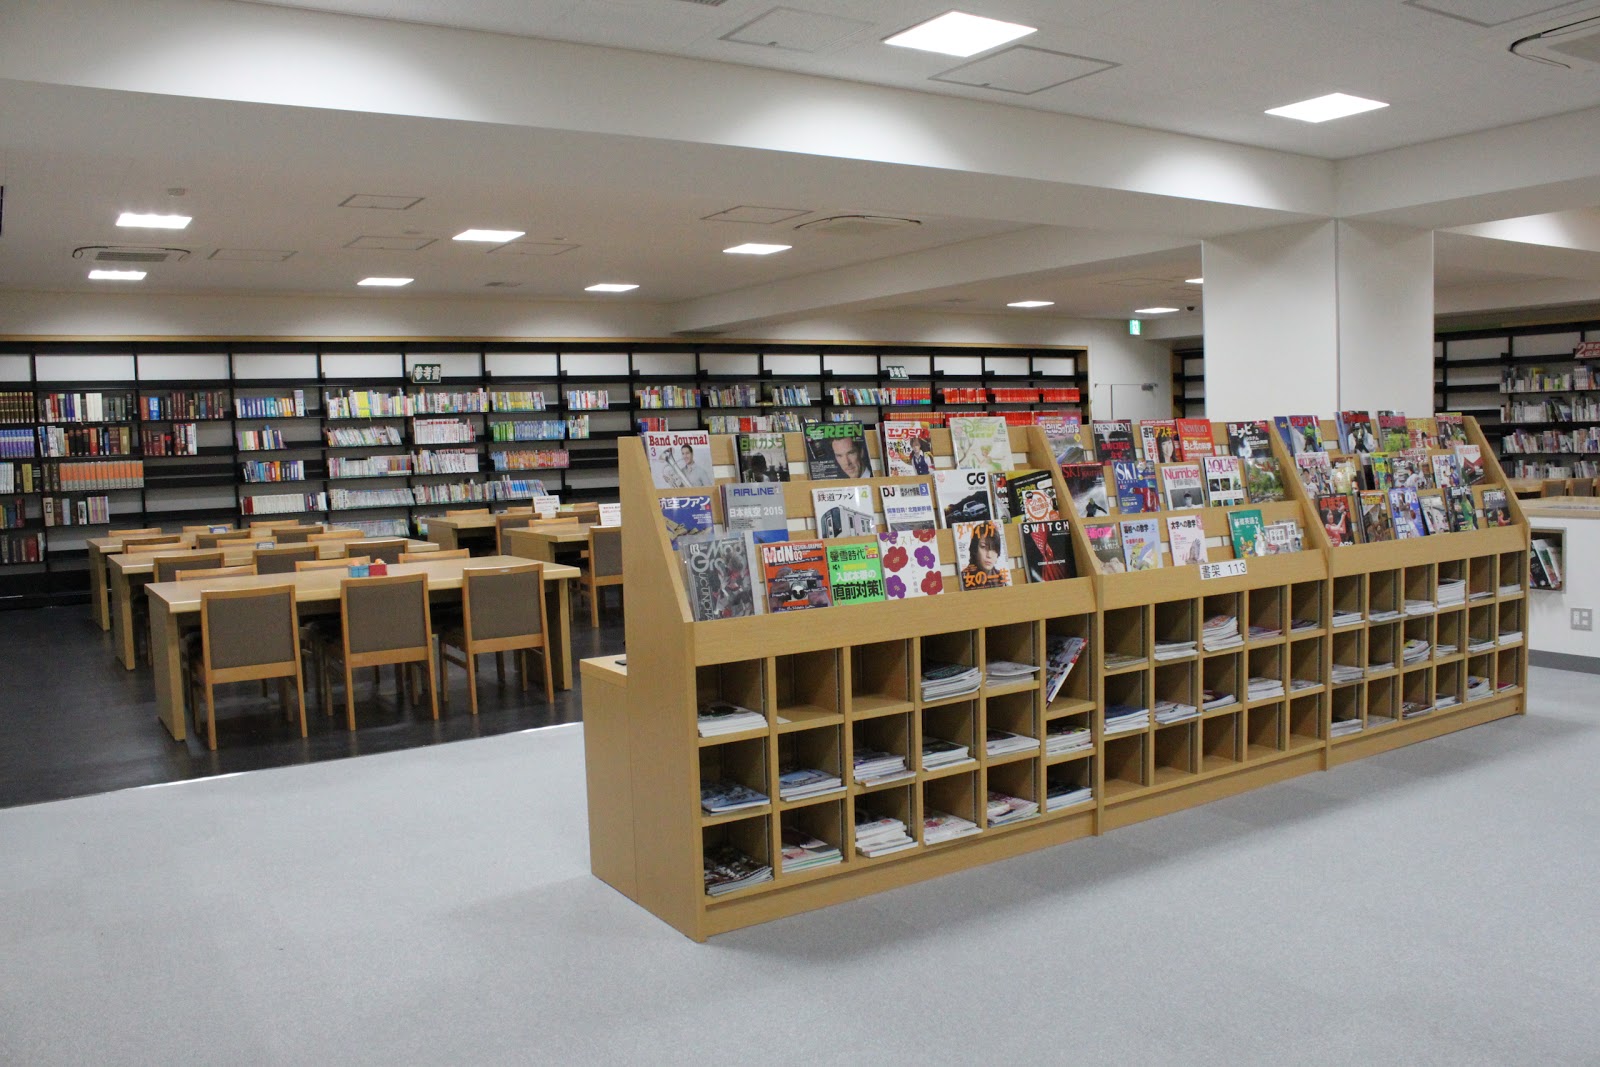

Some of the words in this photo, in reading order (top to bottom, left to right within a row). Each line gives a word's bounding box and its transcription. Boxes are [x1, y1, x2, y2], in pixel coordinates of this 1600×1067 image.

[414, 365, 440, 380] 参考書
[806, 424, 864, 440] SCREEN
[1093, 422, 1131, 434] PRESIDENT
[1154, 426, 1177, 438] アスキー
[1180, 422, 1208, 434] Newton
[648, 435, 671, 446] Band
[673, 434, 708, 446] Journal
[740, 437, 784, 452] 日本カメラ
[651, 447, 657, 457] 3
[1206, 459, 1234, 475] AQUA
[966, 472, 986, 486] CG
[1164, 468, 1199, 480] Number
[733, 487, 774, 497] AIRLINE
[817, 492, 855, 503] 鉄道ファン
[883, 486, 895, 497] DJ
[763, 506, 784, 516] 2015
[1023, 521, 1070, 534] SWITCH
[763, 545, 795, 564] MdN
[794, 550, 802, 560] 03
[1201, 564, 1221, 578] 書架
[1228, 562, 1247, 574] 113
[963, 568, 1011, 588] 女の一生
[832, 579, 884, 601] 直前対策!
